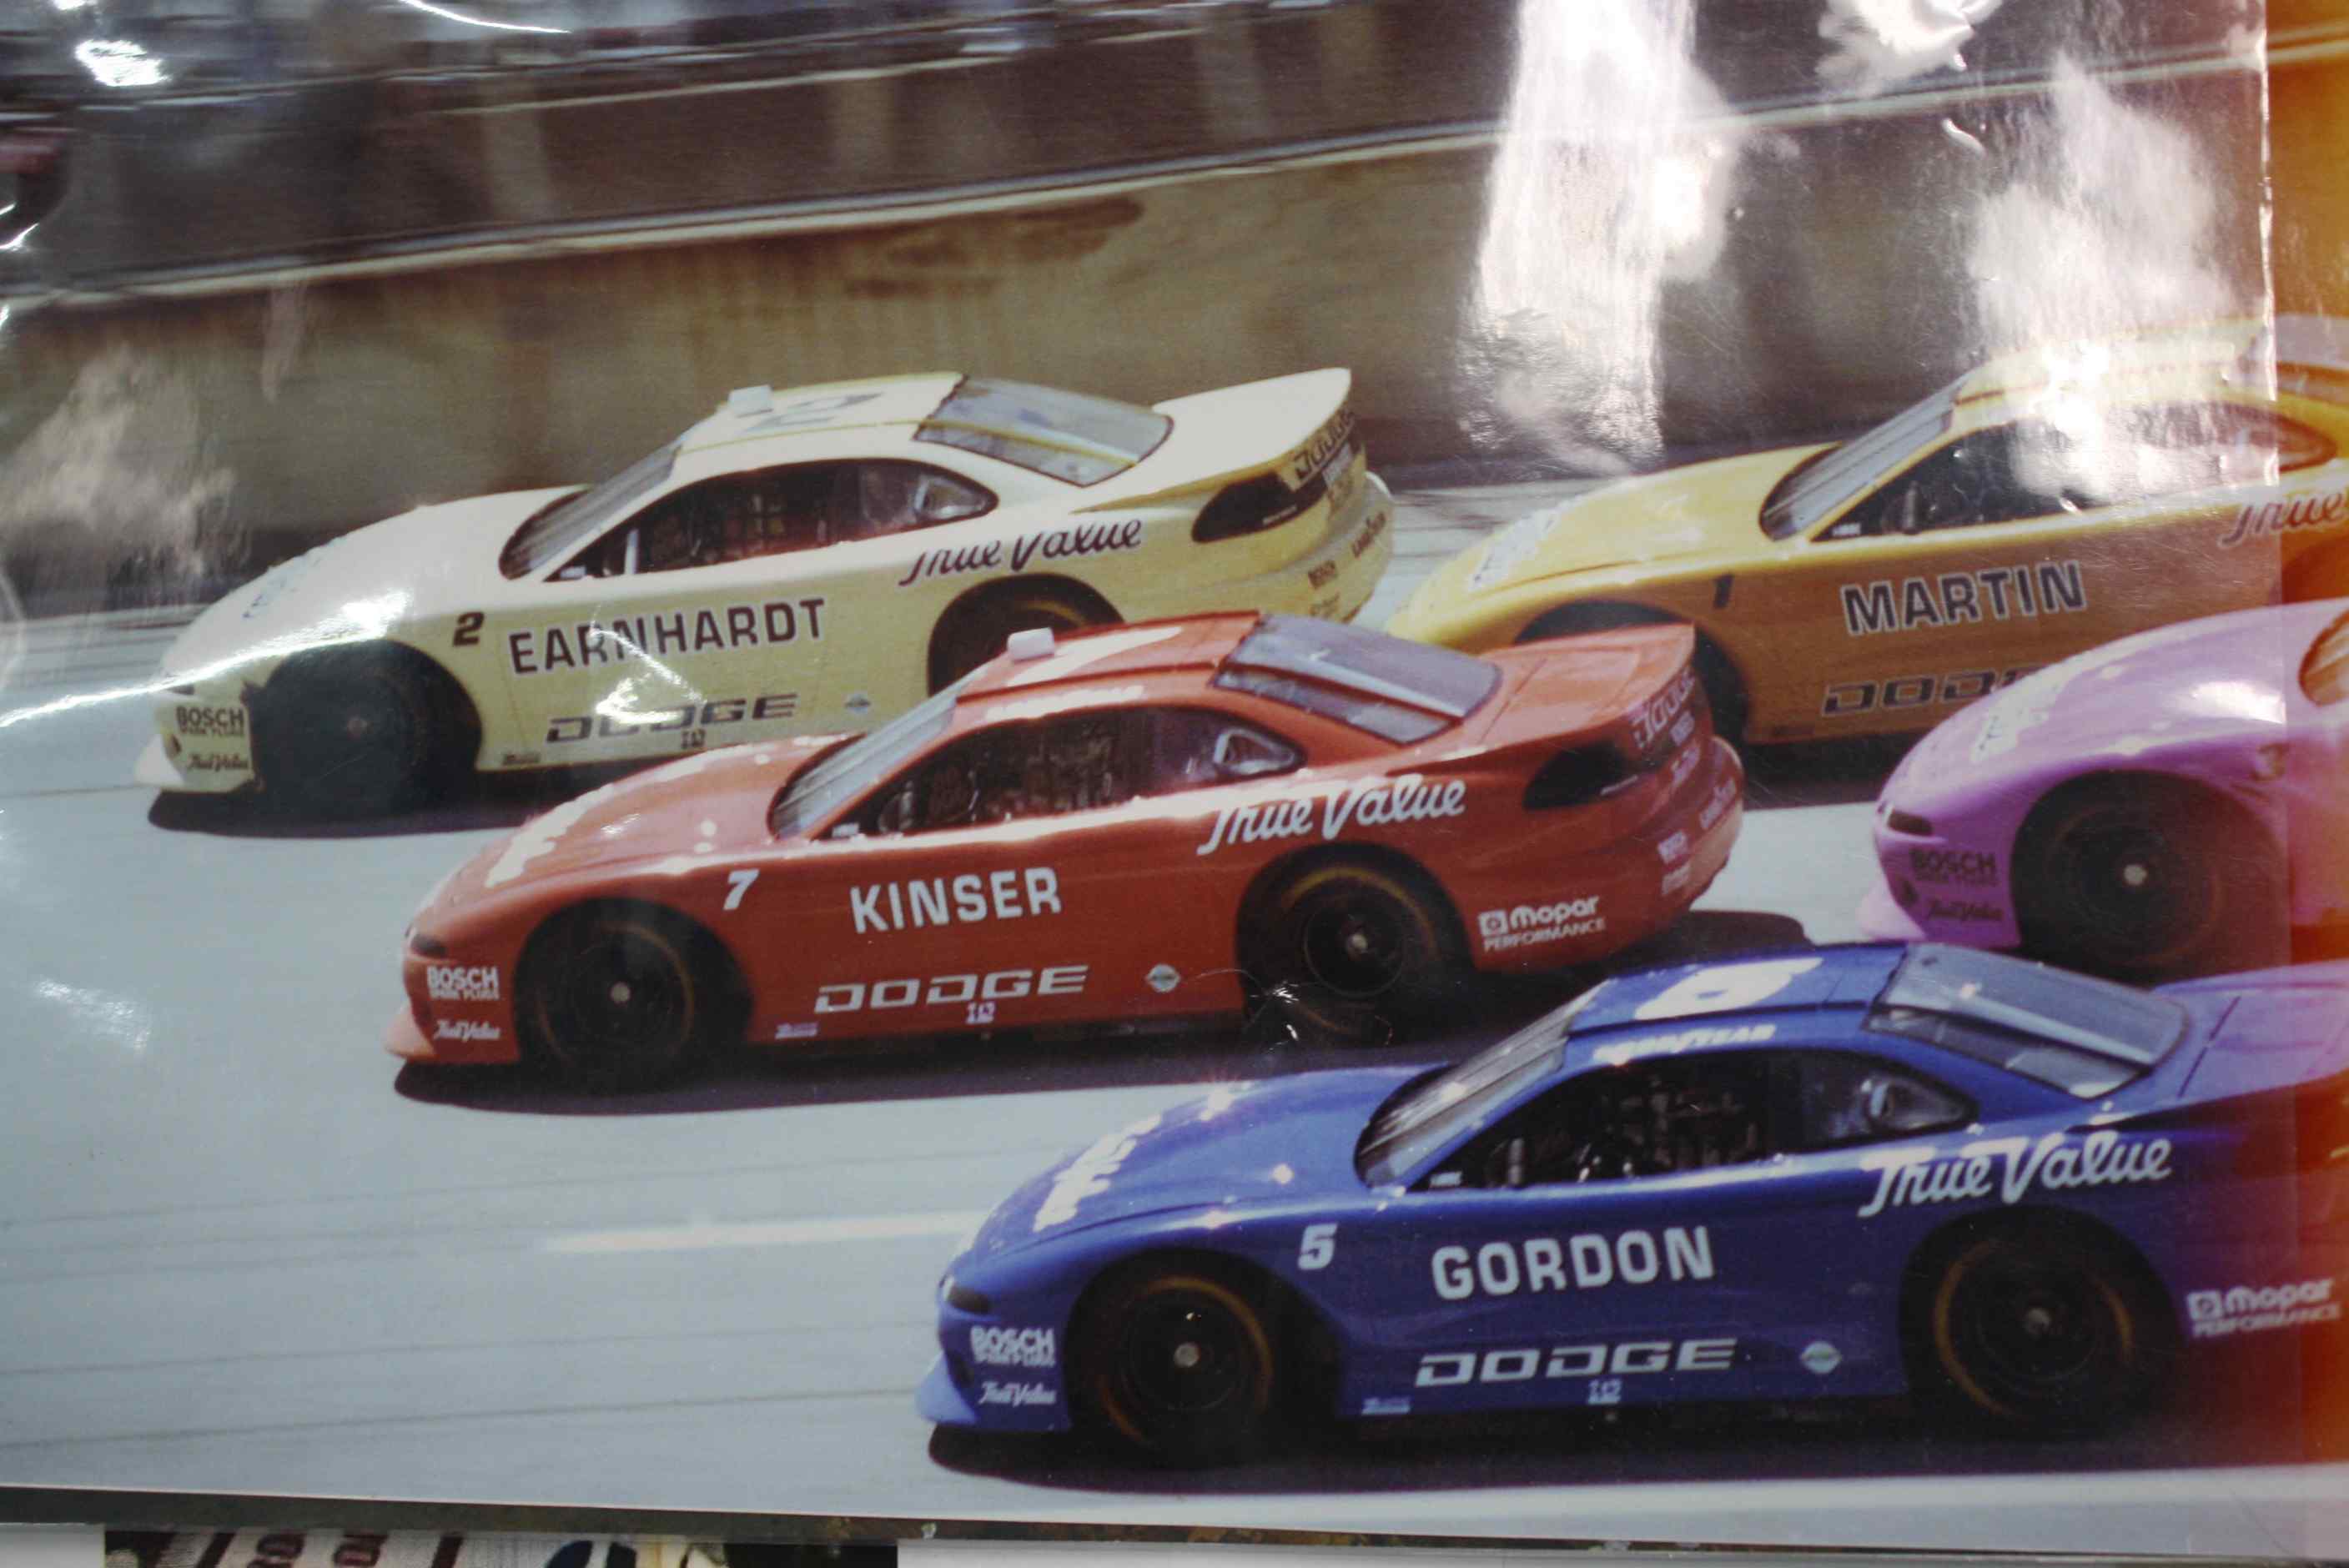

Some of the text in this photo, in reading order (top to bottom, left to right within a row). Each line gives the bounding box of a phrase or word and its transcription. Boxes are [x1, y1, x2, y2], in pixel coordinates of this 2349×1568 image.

[1841, 559, 2087, 636] MARTIN
[452, 611, 485, 647] 2
[509, 597, 826, 675] EARNHARDT
[1821, 666, 2023, 717] DOD
[175, 706, 244, 727] BOSCH
[1195, 773, 1466, 855] True Value
[1908, 847, 1997, 876] BOSCH
[723, 869, 759, 910] 7
[849, 867, 1062, 934] KINSER
[426, 966, 499, 990] BOSCH
[813, 965, 1089, 1014] DODGE
[1857, 1129, 2172, 1218] True Value
[1297, 1223, 1337, 1271] 5
[1431, 1226, 1716, 1301] GORDON
[969, 1324, 1054, 1354] BOSCH
[1415, 1339, 1738, 1388] DODGE
